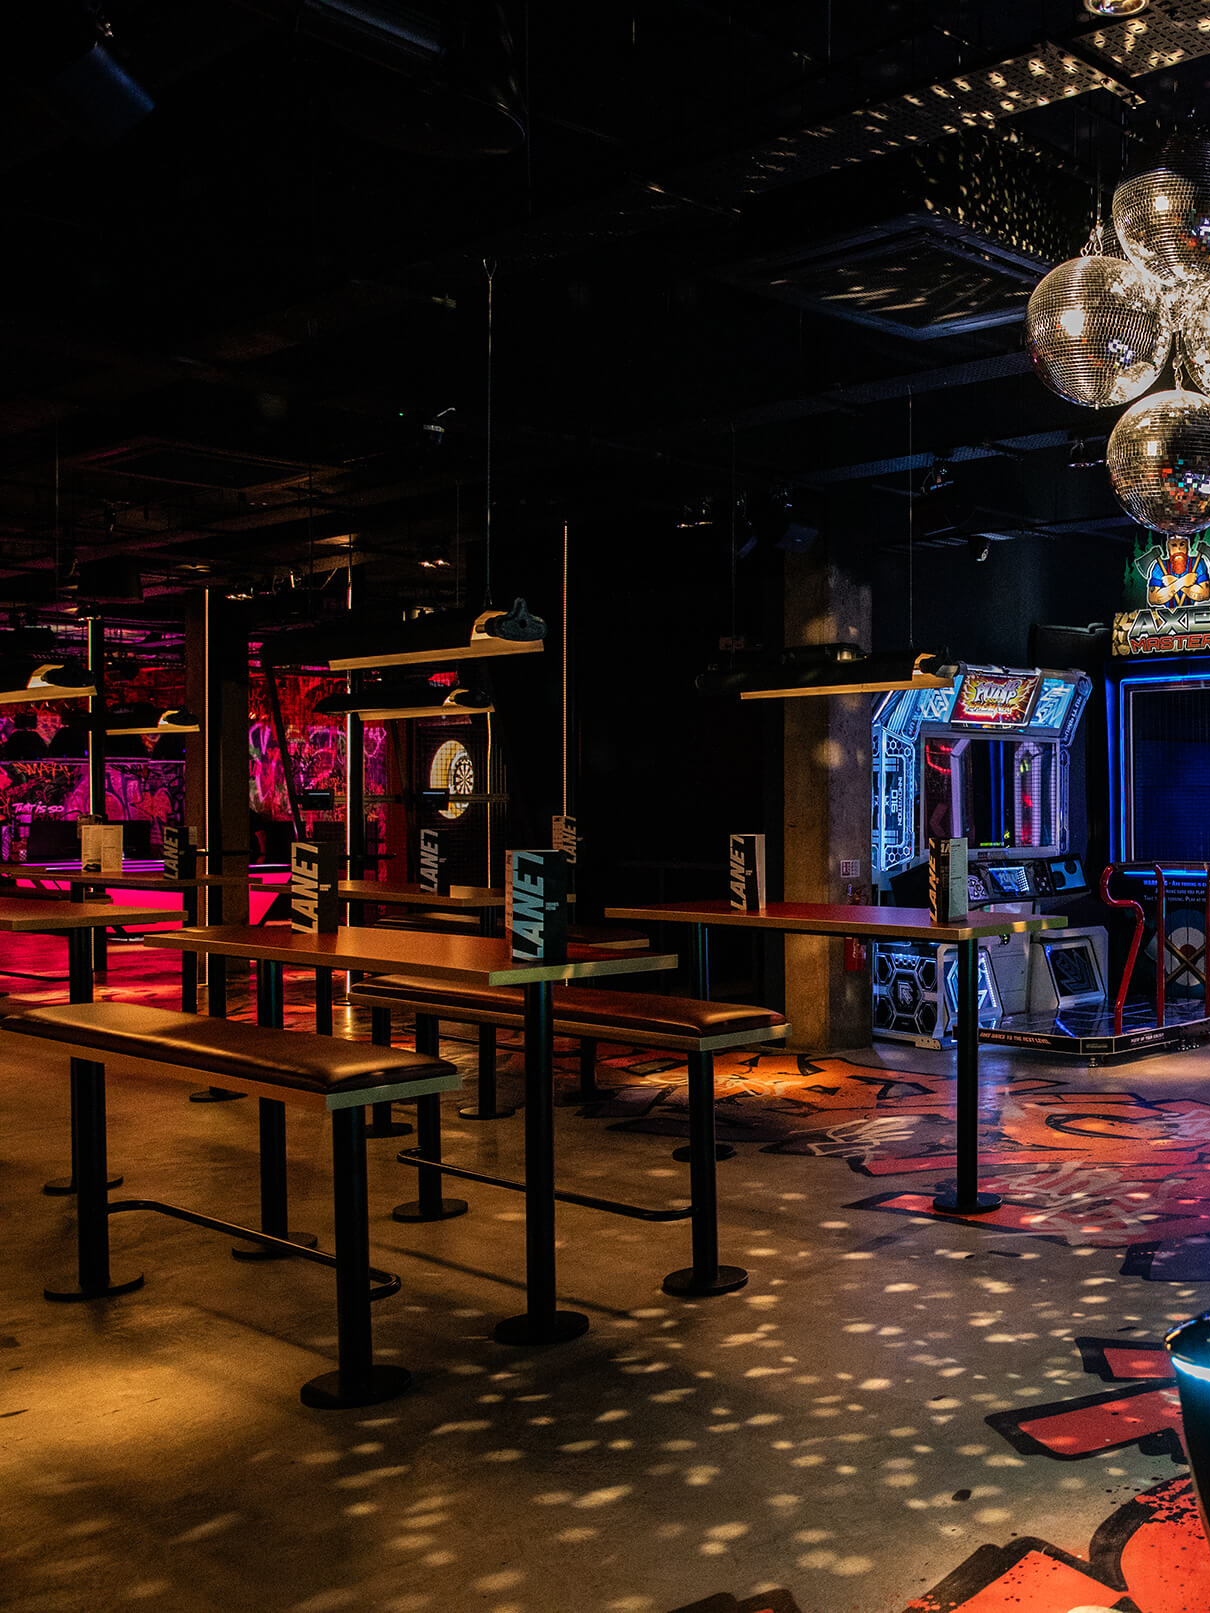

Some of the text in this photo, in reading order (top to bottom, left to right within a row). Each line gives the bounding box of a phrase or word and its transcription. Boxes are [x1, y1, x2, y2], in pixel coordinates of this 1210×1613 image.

[974, 682, 1018, 704] PUMP
[163, 826, 180, 880] LANE7
[419, 828, 439, 893] LANE7
[563, 815, 577, 864] LANE7
[291, 841, 320, 933] LANE7
[730, 836, 745, 910] LANE7
[512, 851, 545, 961] LANE7
